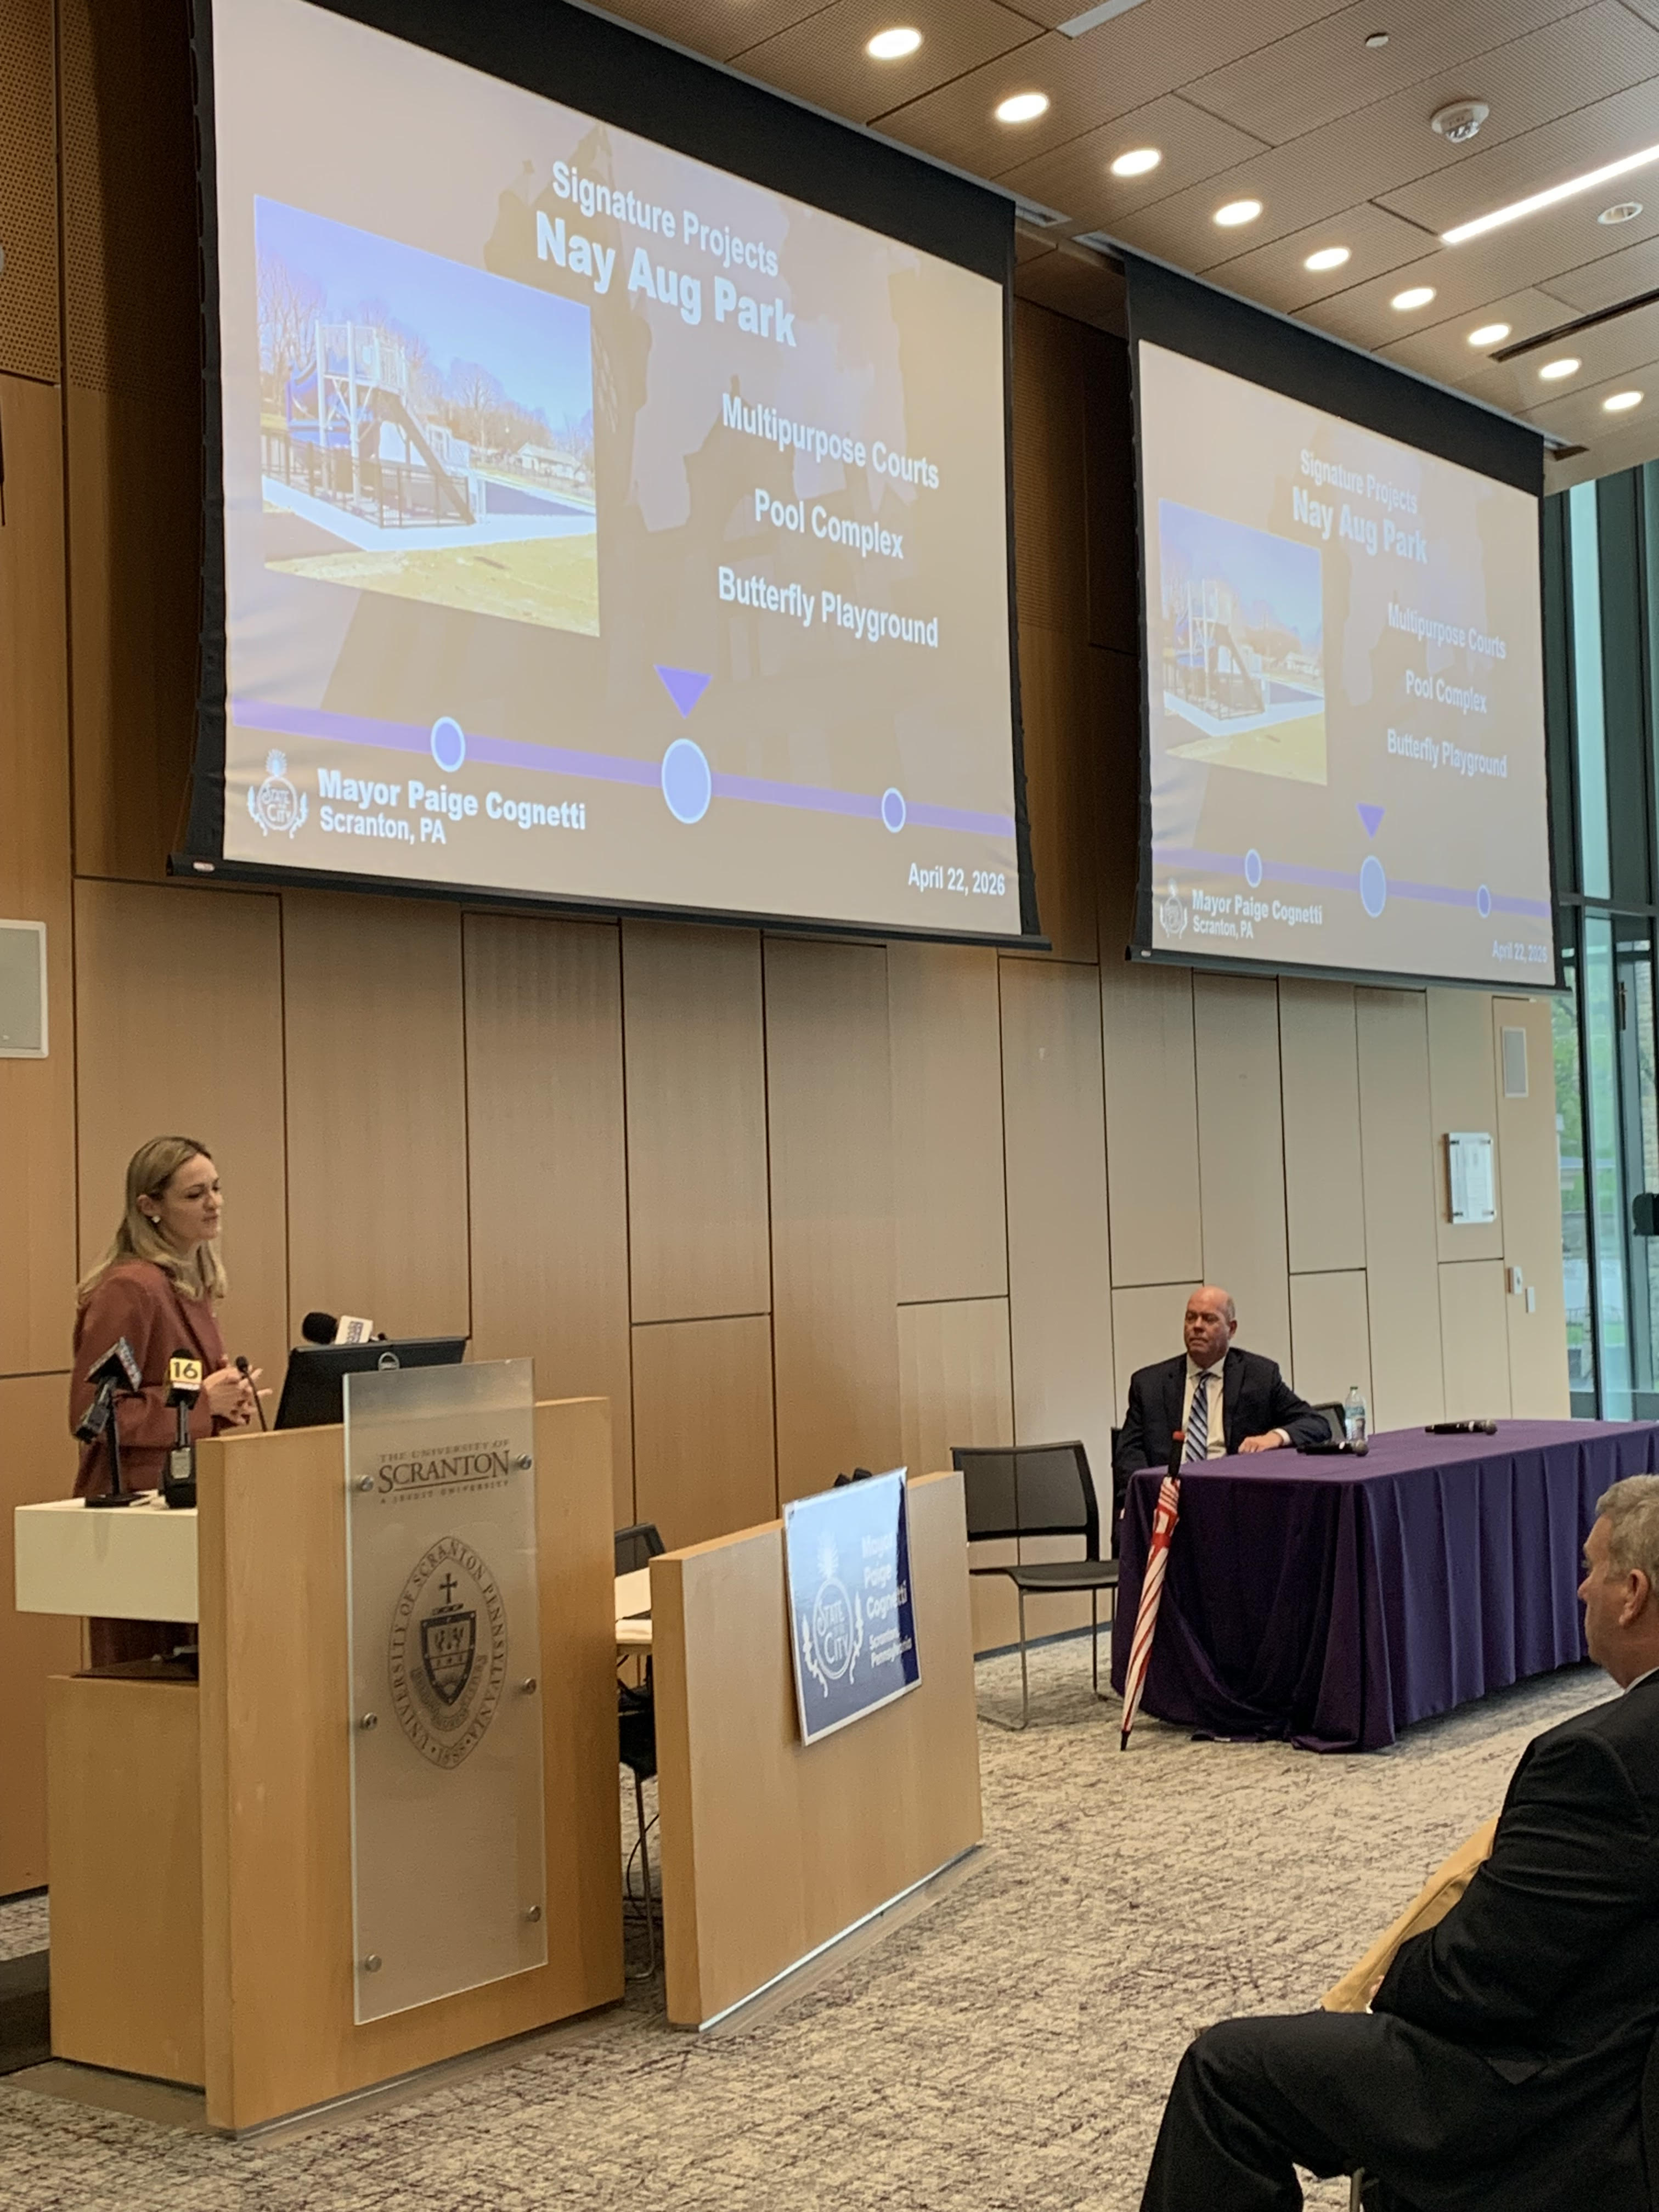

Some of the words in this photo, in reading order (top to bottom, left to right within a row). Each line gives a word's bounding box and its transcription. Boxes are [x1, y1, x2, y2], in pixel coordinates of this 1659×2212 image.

[553, 161, 675, 237] Signature
[684, 210, 778, 277] Projects
[536, 211, 616, 294] Nay
[628, 248, 702, 325] Aug
[715, 275, 797, 347] Park
[723, 393, 866, 467] Multipurpose
[872, 441, 939, 489] Courts
[1301, 449, 1363, 494] Signature
[1367, 474, 1417, 514] Projects
[755, 488, 804, 533] Pool
[811, 505, 904, 559] Complex
[1293, 486, 1333, 540] Nay
[1339, 504, 1378, 556] Aug
[1384, 519, 1427, 564] Park
[719, 566, 815, 627] Butterfly
[822, 590, 938, 648] Playground
[1389, 602, 1465, 647] Multipurpose
[1469, 628, 1506, 659] Courts
[1406, 669, 1433, 699] Pool
[1436, 678, 1487, 715] Complex
[1387, 728, 1439, 769] Butterfly
[1442, 741, 1507, 778] Playground
[317, 768, 401, 810] Mayor
[408, 780, 478, 820] Paige
[486, 792, 586, 830] Cognetti
[320, 806, 415, 845] Scranton,
[420, 818, 447, 844] PA
[908, 862, 943, 893] April
[947, 867, 968, 896] 22,
[973, 870, 1005, 896] 2026
[1192, 889, 1232, 916] Mayor
[1235, 895, 1268, 922] Paige
[1272, 900, 1323, 926] Cognetti
[1193, 915, 1238, 940] Scranton,
[1240, 919, 1254, 939] PA
[1492, 939, 1513, 962] April
[1514, 942, 1527, 964] 22,
[174, 1362, 198, 1379] 16
[378, 1450, 510, 1493] SCRANTON
[379, 1453, 408, 1463] THE
[411, 1442, 489, 1459] UNIVERSITY
[492, 1439, 510, 1448] OF
[413, 1538, 485, 1584] SCRANTON
[864, 1561, 891, 1589] Paige
[400, 1593, 416, 1617] OF
[867, 1579, 907, 1619] Cognetti
[391, 1624, 432, 1751] UNIVERSITY
